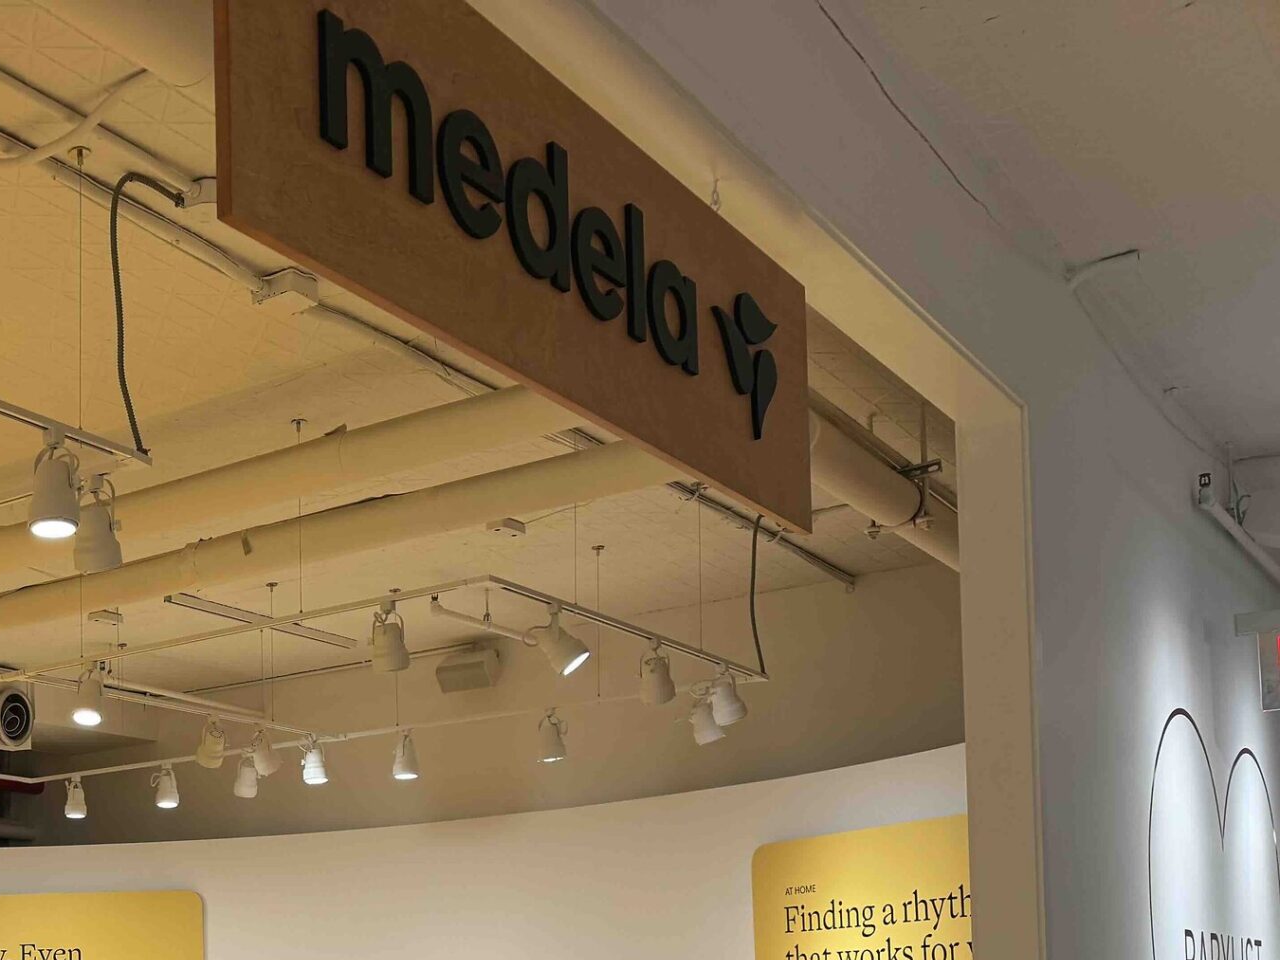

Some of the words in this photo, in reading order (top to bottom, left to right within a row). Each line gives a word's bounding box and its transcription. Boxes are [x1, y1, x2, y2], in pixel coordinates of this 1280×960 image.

[317, 9, 699, 376] medela
[785, 886, 794, 895] AT
[795, 884, 816, 895] HOME
[784, 899, 876, 938] Finding
[882, 903, 897, 925] a
